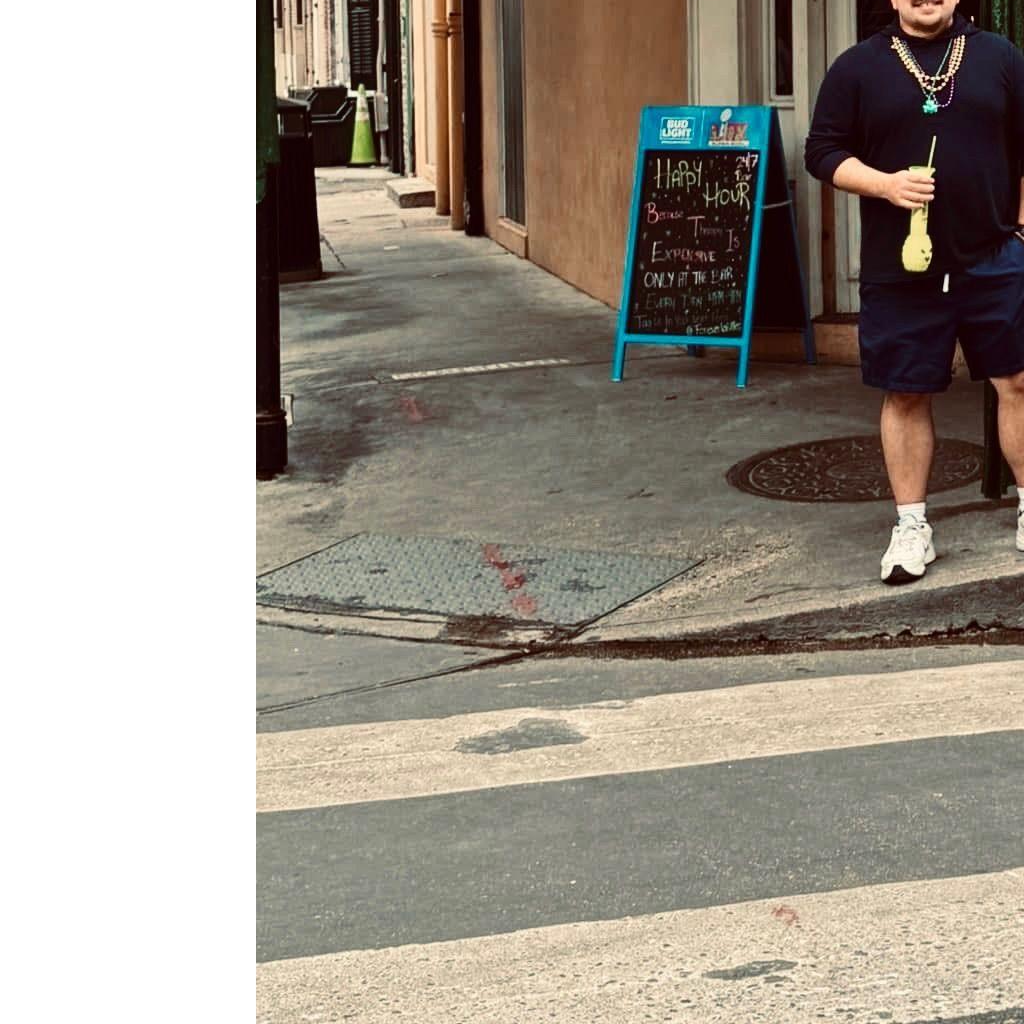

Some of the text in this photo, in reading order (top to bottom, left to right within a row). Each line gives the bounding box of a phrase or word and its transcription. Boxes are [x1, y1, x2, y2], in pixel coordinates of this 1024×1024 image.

[667, 119, 689, 129] BUD
[663, 128, 692, 138] LIGHT
[643, 271, 675, 289] ONLY
